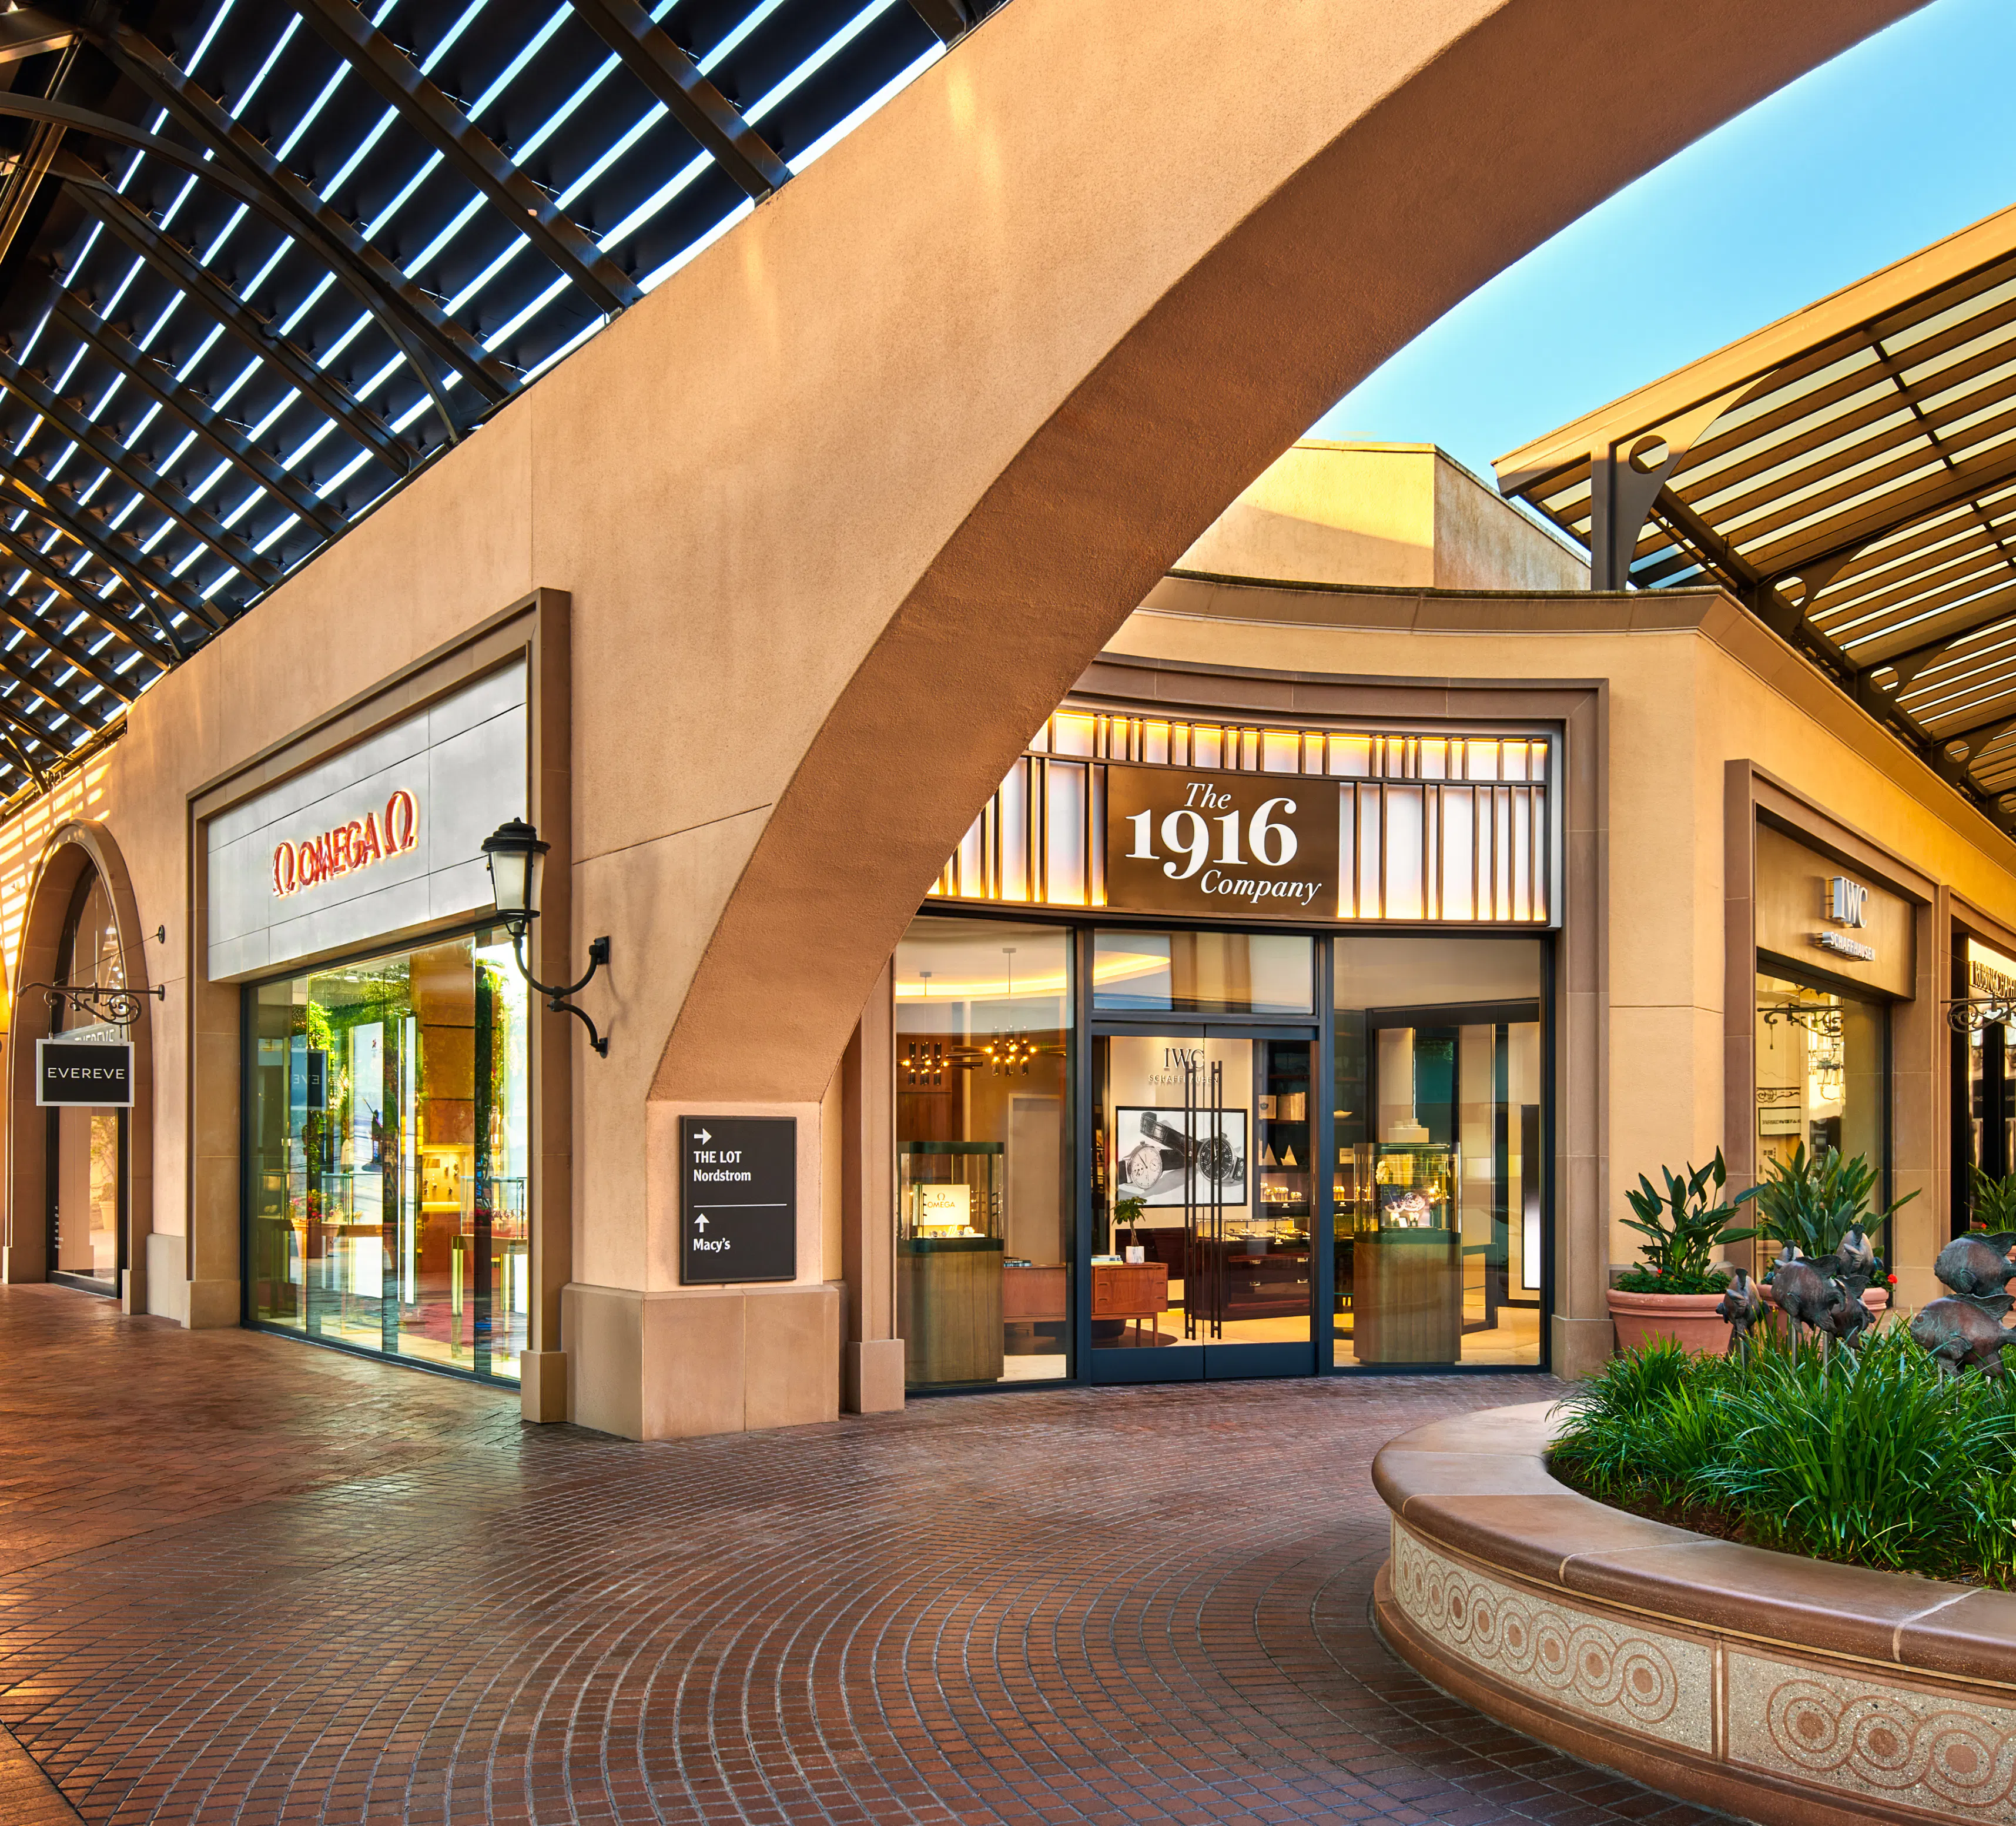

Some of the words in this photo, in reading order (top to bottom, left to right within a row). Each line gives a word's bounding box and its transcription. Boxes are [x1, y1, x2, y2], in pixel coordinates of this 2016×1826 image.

[1184, 782, 1231, 810] The
[299, 812, 383, 886] OMEGA
[1124, 797, 1298, 879] 1916
[1200, 869, 1322, 906] Company
[1832, 876, 1868, 928] IWC
[1822, 931, 1876, 961] SCHAFFHAUSEN
[1164, 1048, 1204, 1069] IWC
[48, 1067, 125, 1079] EVEREVE
[693, 1151, 716, 1164] THE
[720, 1151, 742, 1163] LOT
[694, 1169, 751, 1182] Nordstrom
[693, 1238, 731, 1253] Macy's
